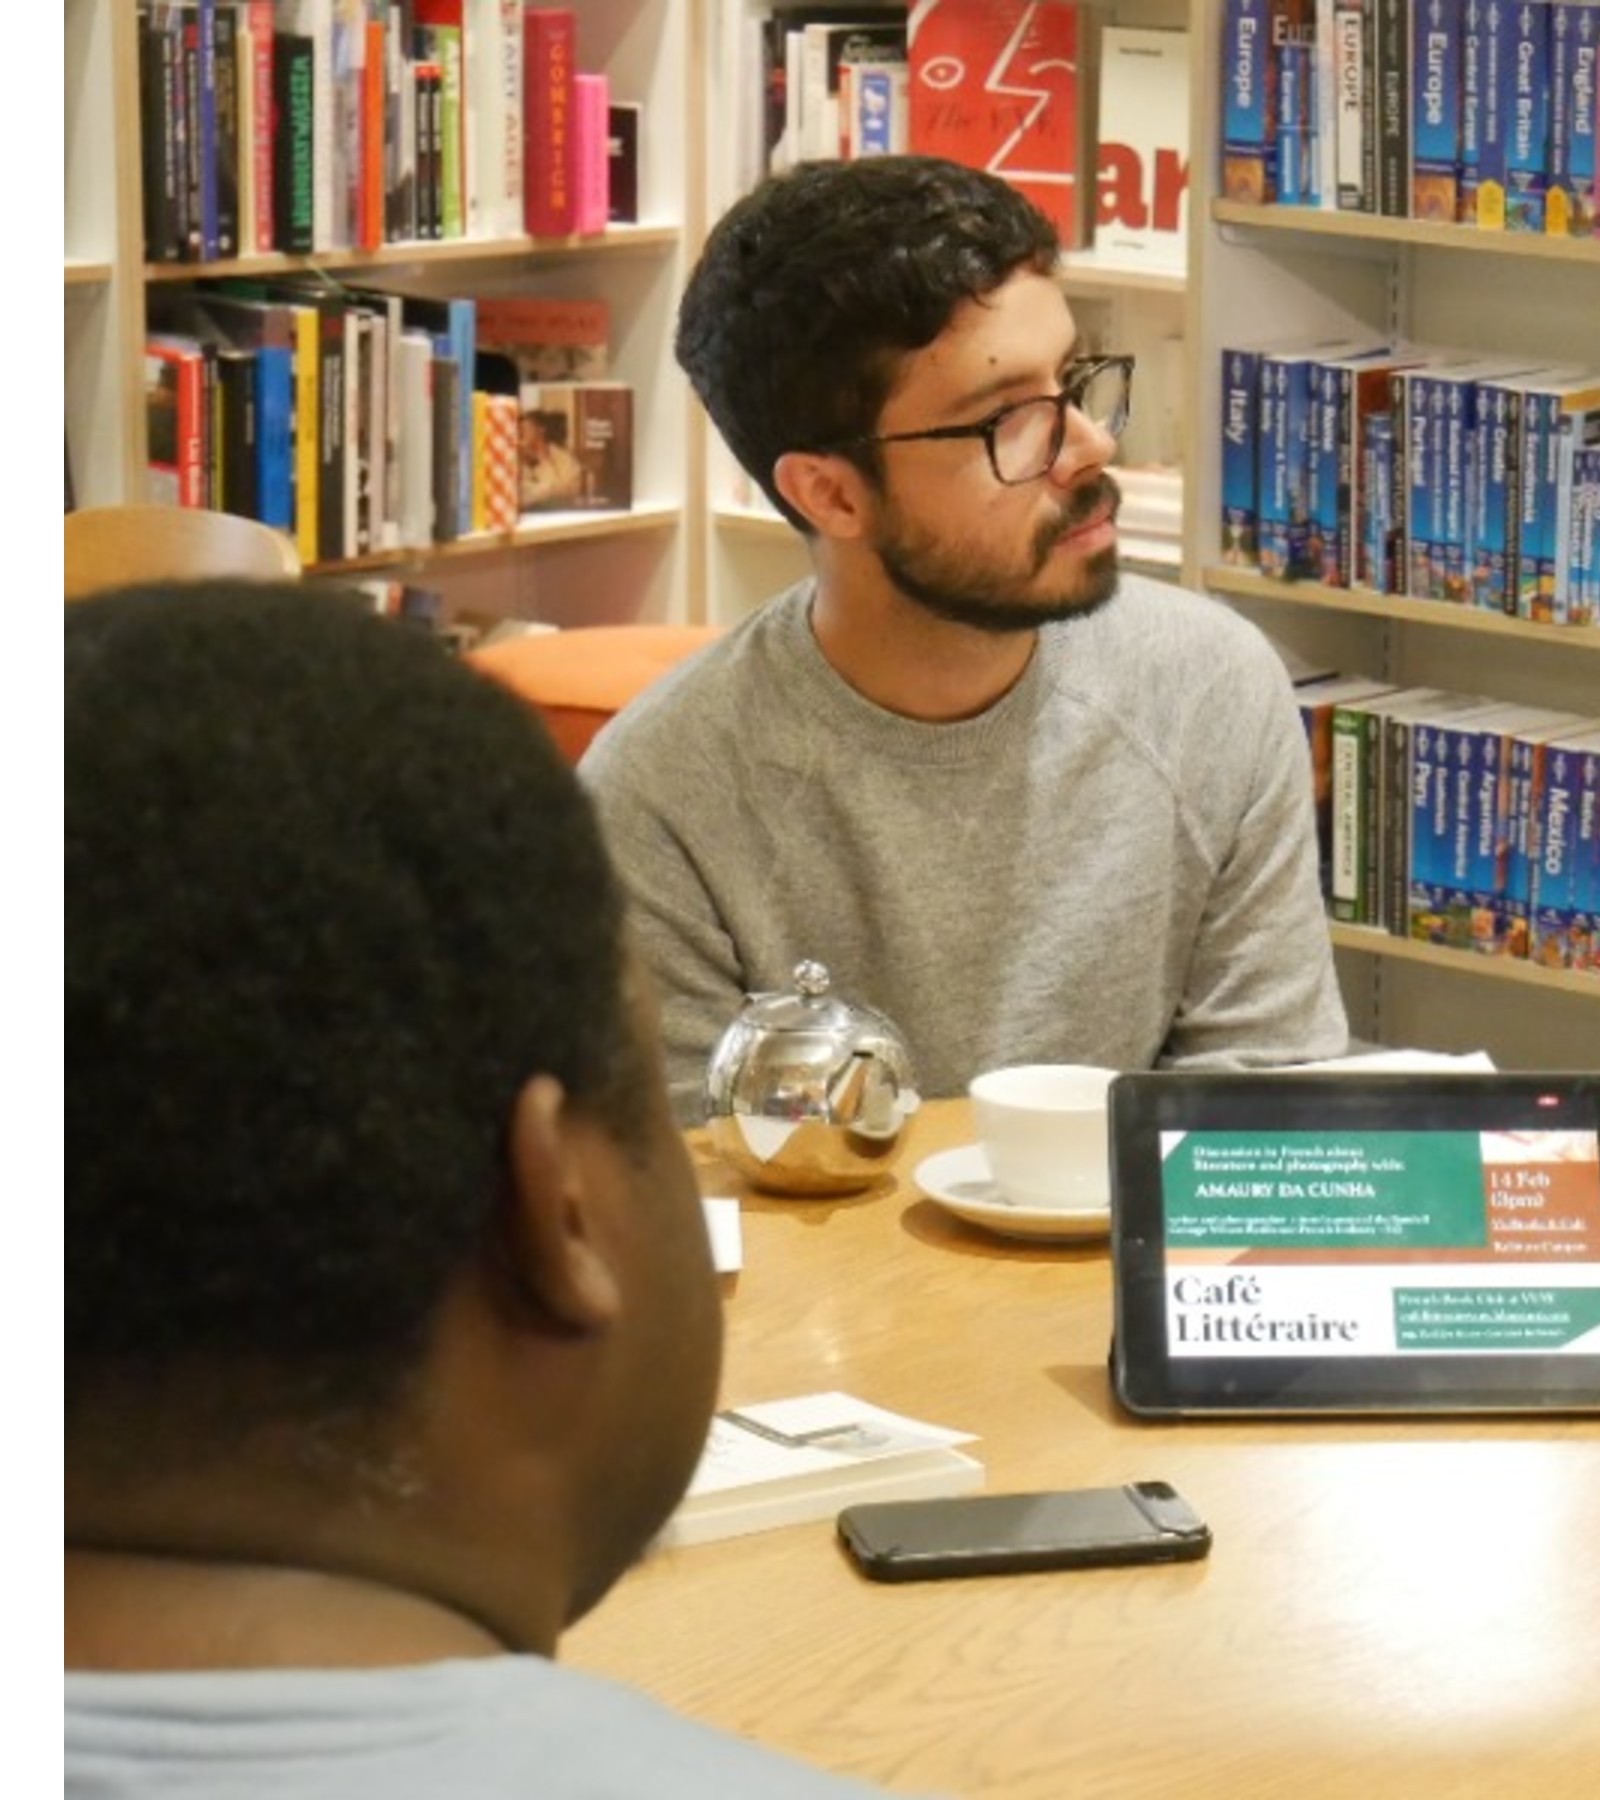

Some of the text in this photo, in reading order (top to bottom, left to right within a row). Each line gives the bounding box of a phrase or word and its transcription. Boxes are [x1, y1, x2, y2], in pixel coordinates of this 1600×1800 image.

[1237, 17, 1257, 109] Europe
[1344, 19, 1361, 112] EUROPE
[1424, 32, 1449, 125] Europe
[1573, 47, 1595, 135] England
[1385, 70, 1401, 138] EUROPE
[1516, 41, 1535, 161] Great Britain
[1226, 388, 1248, 445] Italy
[1411, 416, 1427, 487] Portugal
[1415, 762, 1433, 808] Peru
[1478, 771, 1497, 857] Argentina
[1544, 788, 1571, 875] Mexico
[1193, 1158, 1256, 1172] literature
[1260, 1158, 1283, 1171] and
[1285, 1158, 1368, 1175] photography
[1281, 1145, 1325, 1158] French
[1490, 1171, 1552, 1188] 14 Feb
[1194, 1181, 1376, 1199] AMAURY DA CUNHA
[1173, 1274, 1262, 1306] Café
[1176, 1312, 1359, 1342] Littéraire
